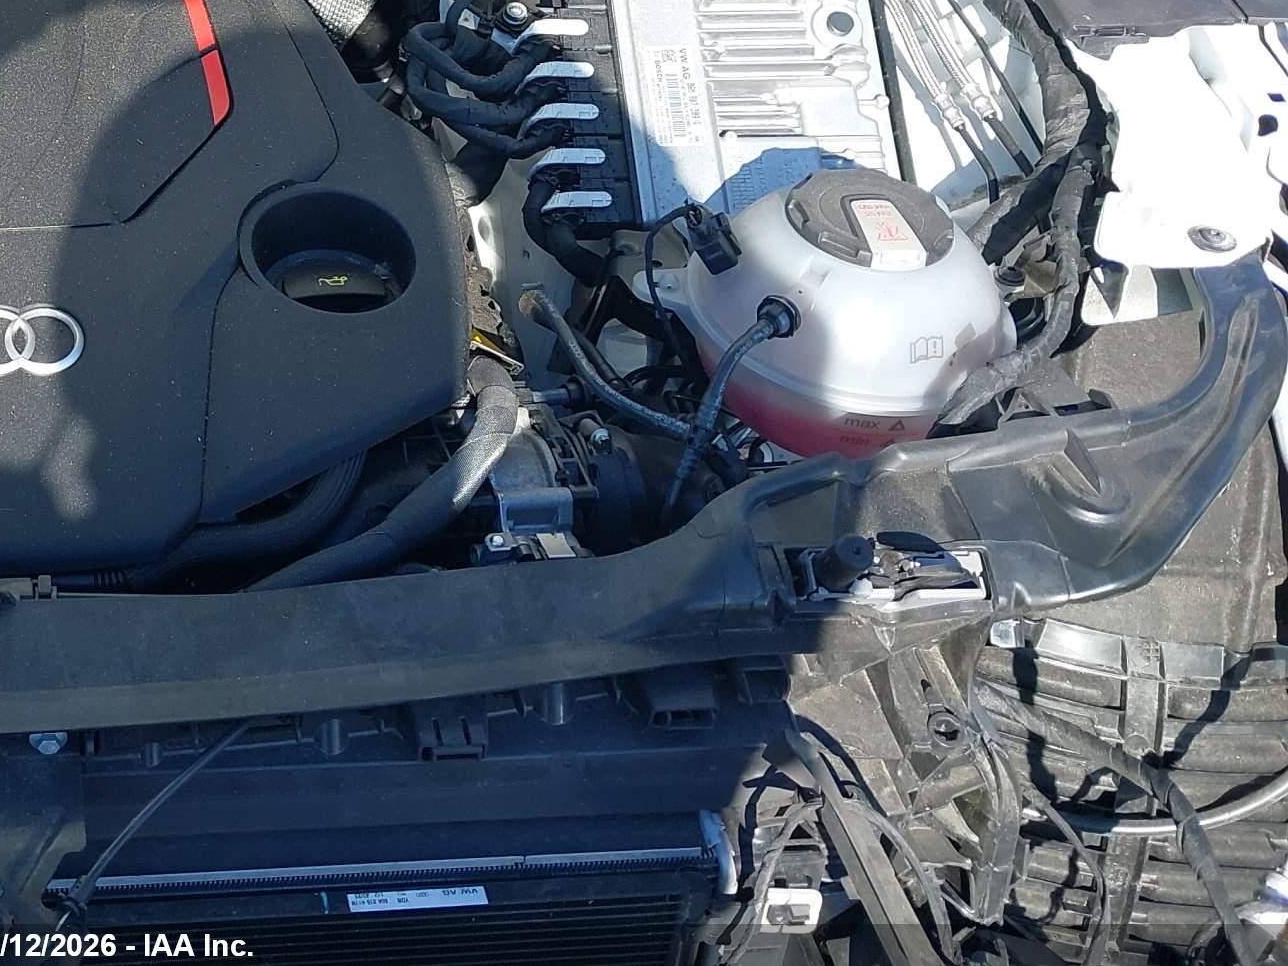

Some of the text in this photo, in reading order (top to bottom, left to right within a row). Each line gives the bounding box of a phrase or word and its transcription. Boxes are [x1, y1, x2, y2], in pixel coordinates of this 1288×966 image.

[679, 48, 689, 63] VW
[681, 65, 691, 80] AG
[844, 418, 881, 430] max
[460, 888, 479, 896] VW
